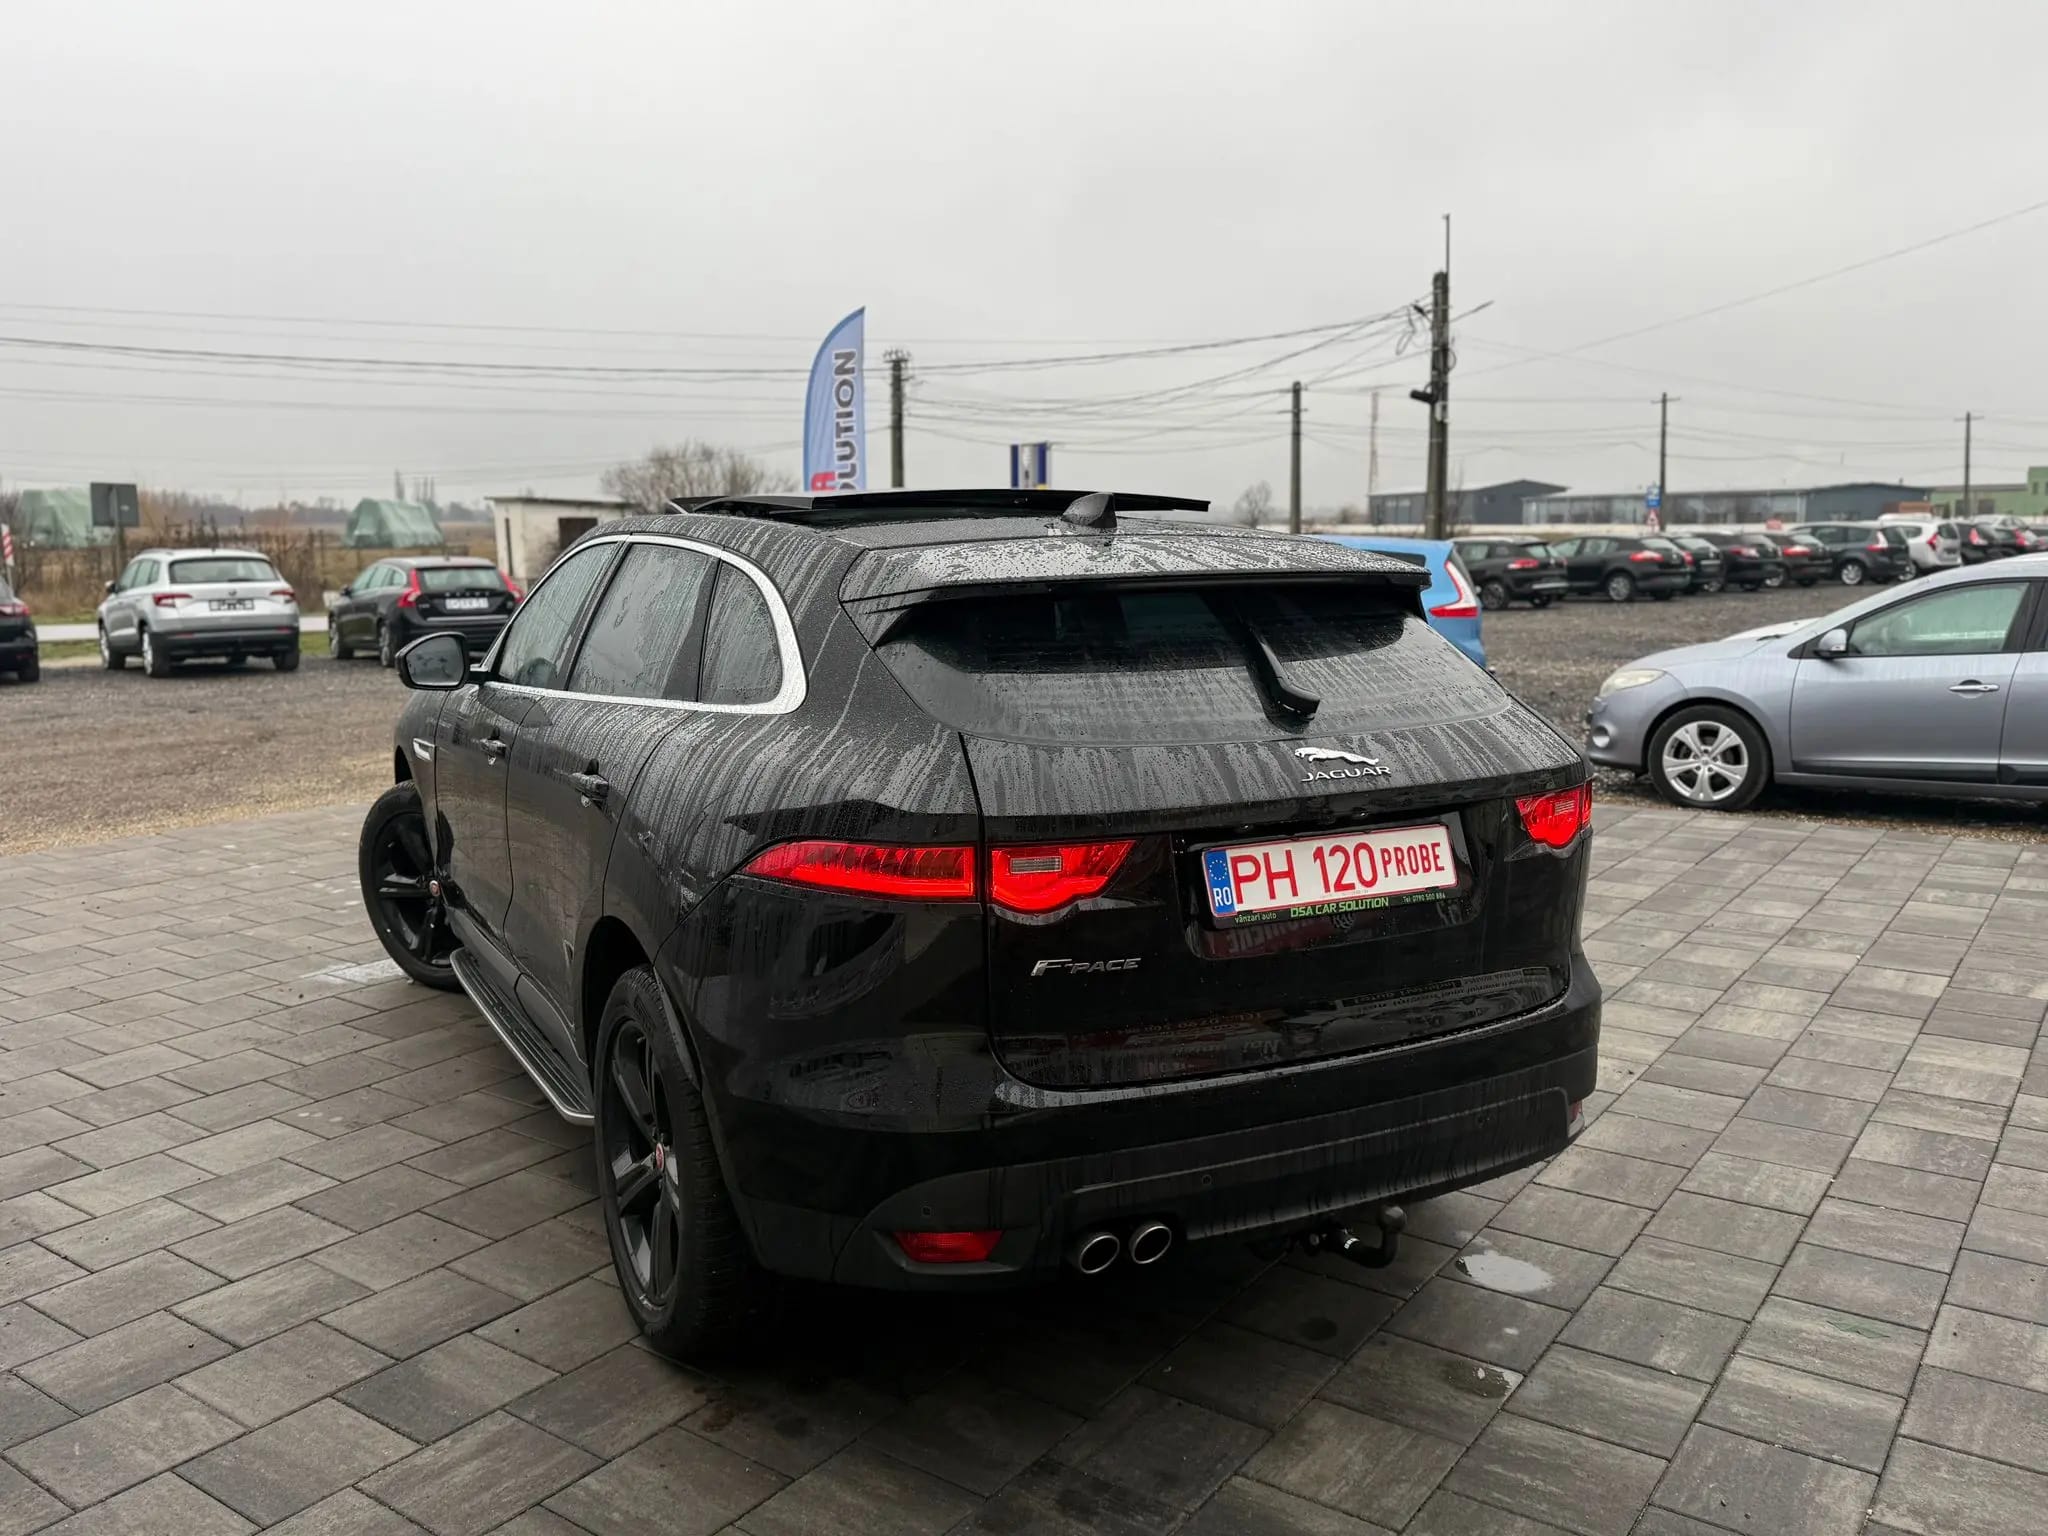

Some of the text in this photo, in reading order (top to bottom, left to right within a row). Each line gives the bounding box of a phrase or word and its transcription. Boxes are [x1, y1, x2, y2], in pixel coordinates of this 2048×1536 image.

[1301, 766, 1391, 782] JAGUAR
[1230, 842, 1445, 905] PH 120 PROBE
[1212, 886, 1232, 907] RO
[1262, 911, 1277, 921] auto
[1290, 897, 1389, 918] DSA CAR SOLUTION
